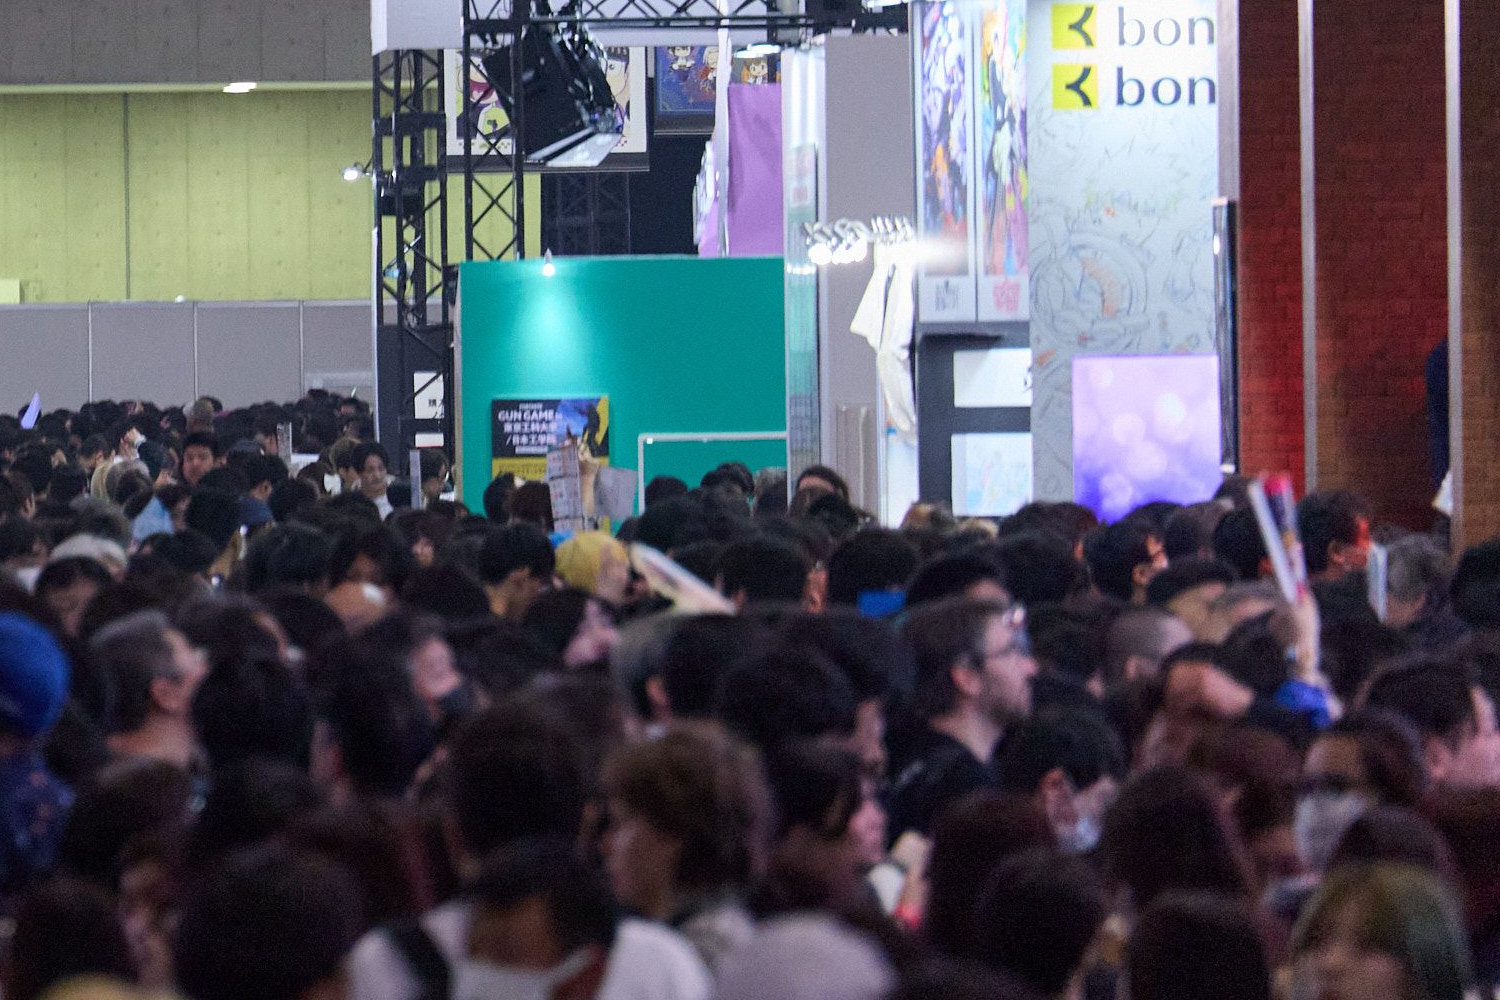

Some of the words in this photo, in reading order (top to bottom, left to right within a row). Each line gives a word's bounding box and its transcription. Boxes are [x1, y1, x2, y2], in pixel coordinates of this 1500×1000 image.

[1117, 5, 1215, 47] bon
[1115, 66, 1217, 107] bon
[498, 409, 522, 422] GUN
[523, 409, 555, 421] GAME
